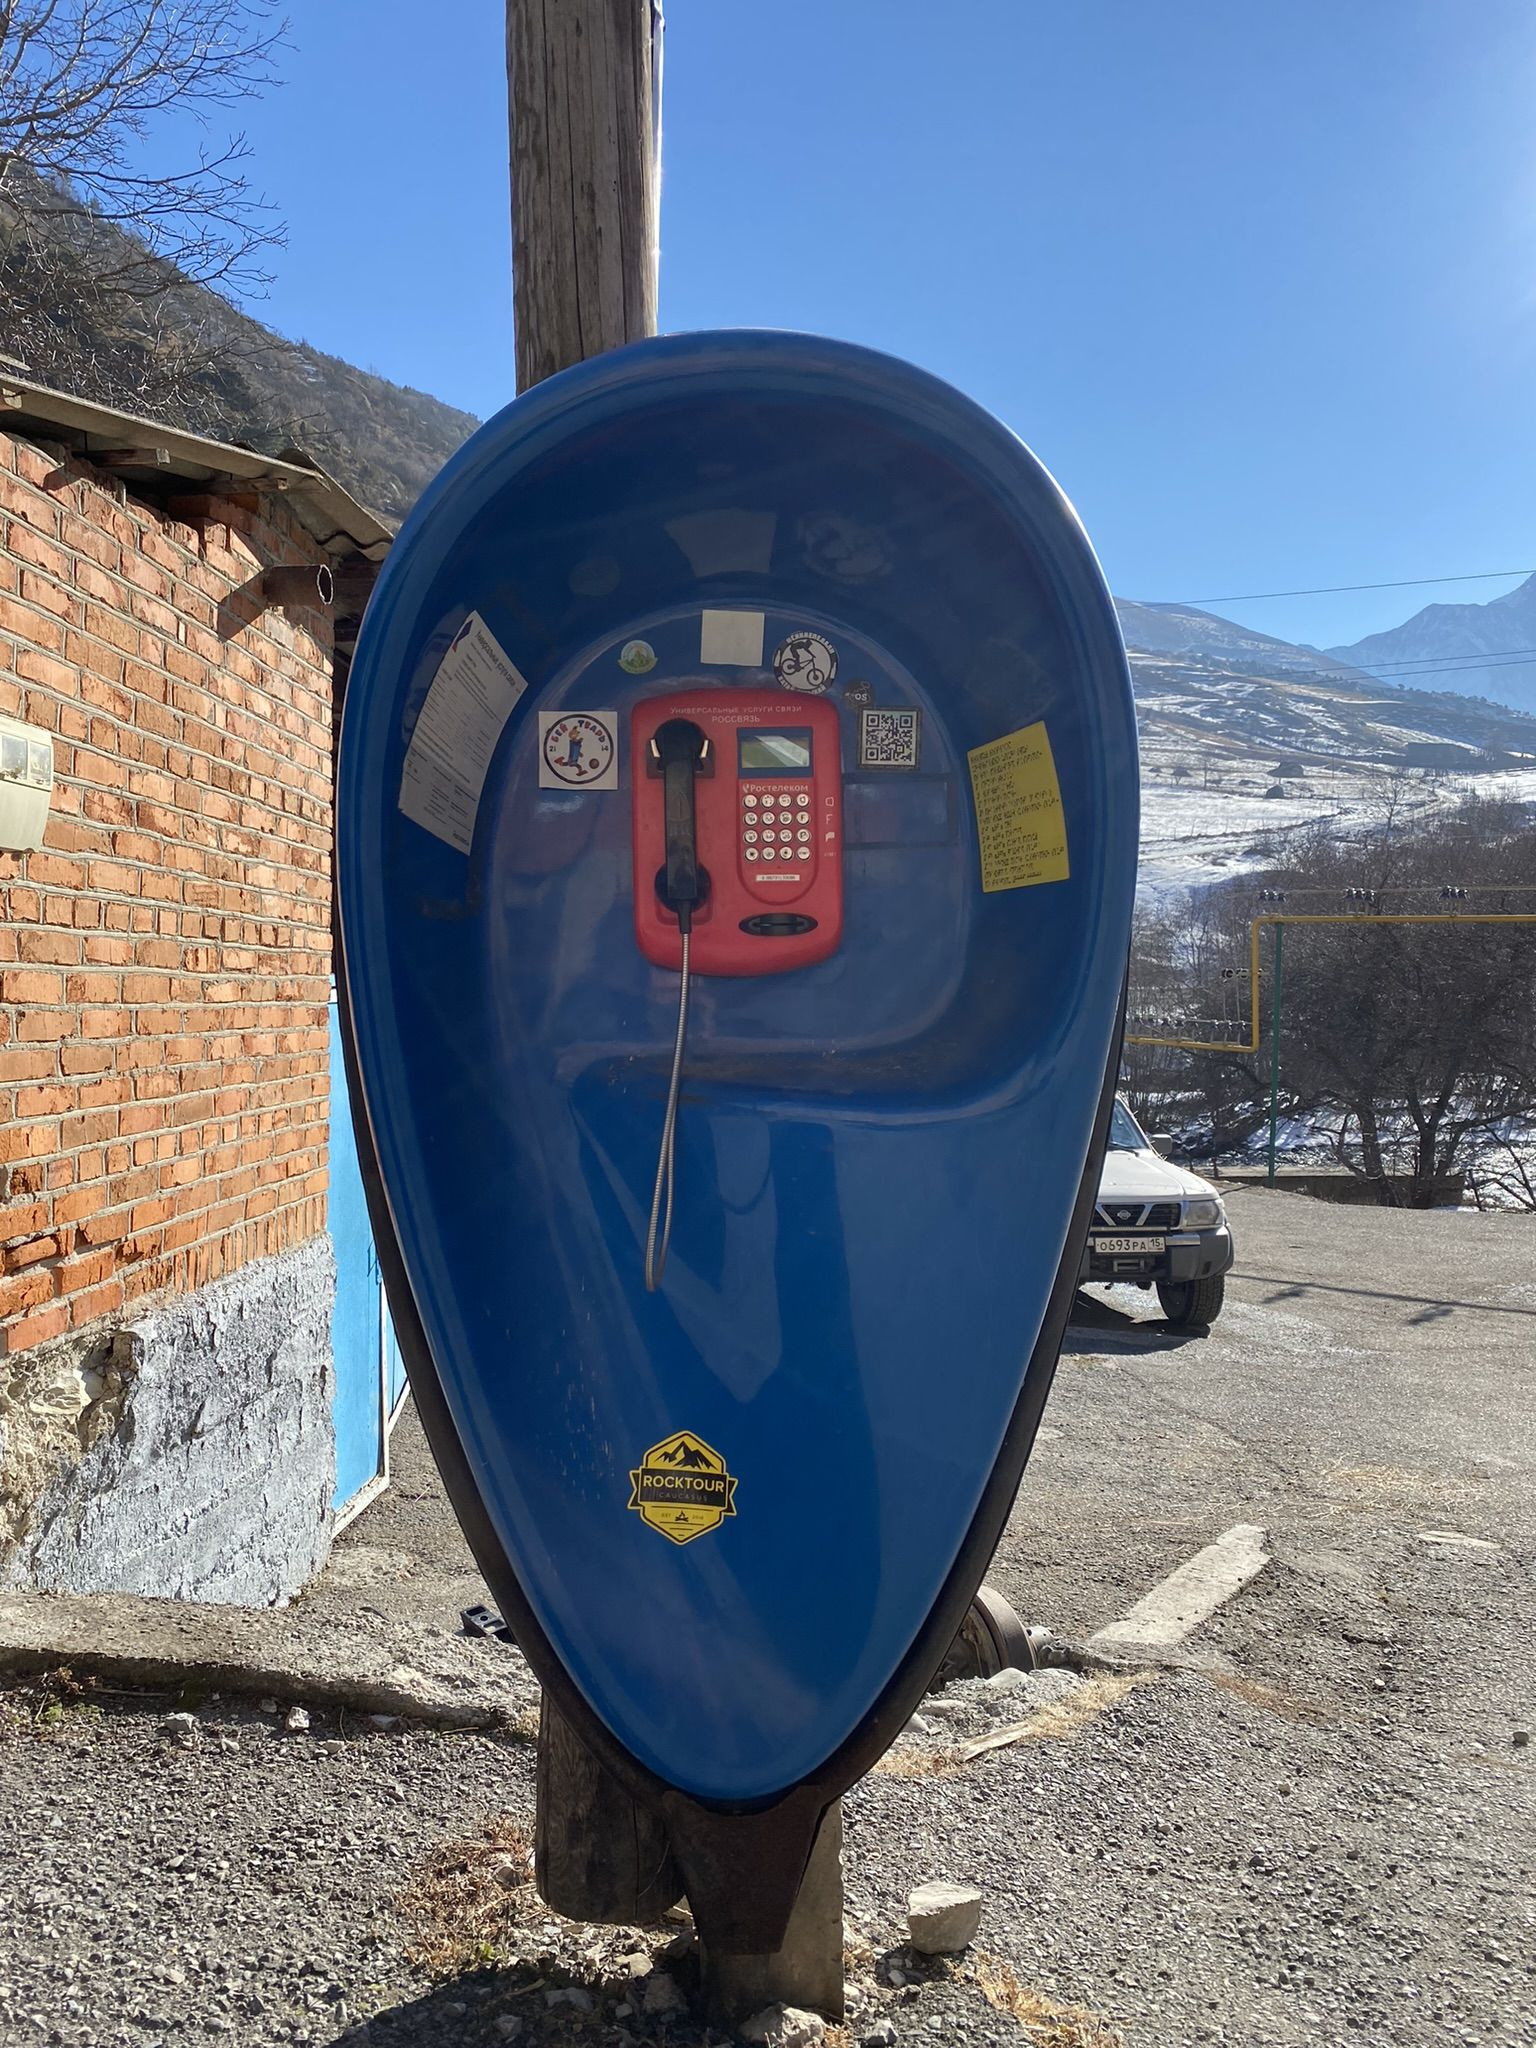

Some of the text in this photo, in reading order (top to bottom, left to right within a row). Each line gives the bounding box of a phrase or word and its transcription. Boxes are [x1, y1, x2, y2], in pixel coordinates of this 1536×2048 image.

[670, 706, 739, 715] УНИВЕРСАЛЬНЫЕ
[775, 705, 802, 713] СВЯЗИ
[711, 715, 761, 723] РОССВЯЗЬ
[577, 719, 607, 743] ТВАРЬ
[750, 783, 809, 793] Ростелеком
[1150, 1238, 1161, 1247] 15
[644, 1475, 724, 1492] ROCKTOUR
[659, 1492, 707, 1501] CAUCASUS
